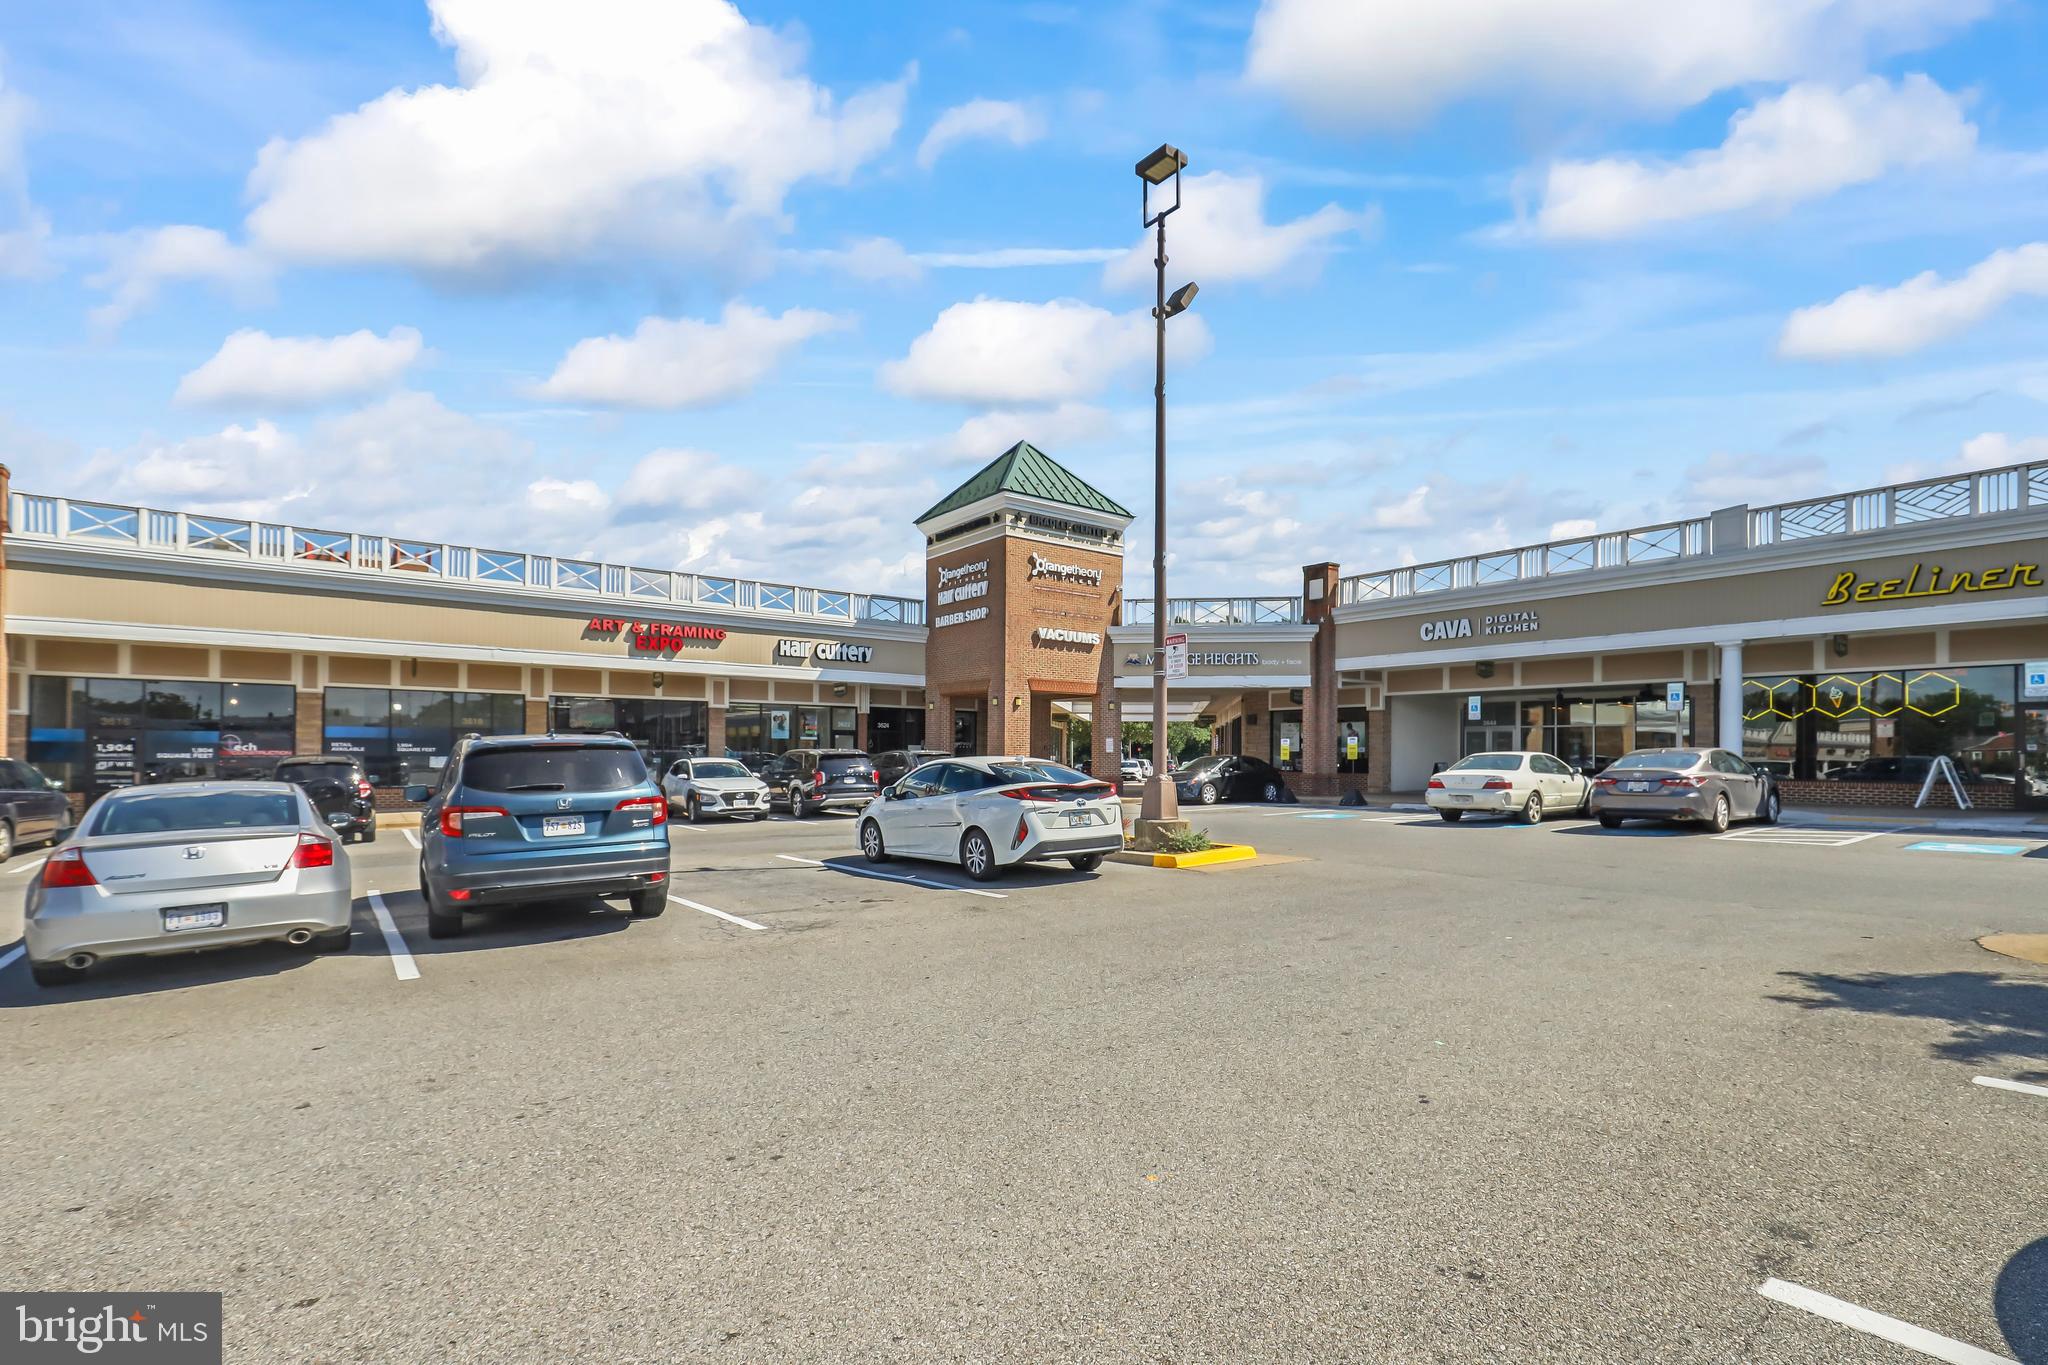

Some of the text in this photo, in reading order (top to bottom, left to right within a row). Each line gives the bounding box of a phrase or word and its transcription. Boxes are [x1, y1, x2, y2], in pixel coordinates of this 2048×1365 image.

[935, 607, 988, 628] BARBER SHOP
[1486, 611, 1538, 624] DIGITAL
[589, 618, 727, 640] ART & FRAMING
[1038, 627, 1101, 645] VACUUMS
[1420, 618, 1472, 641] CAVA
[1485, 622, 1538, 635] KITCHEN
[635, 635, 683, 651] EXPO
[779, 639, 811, 657] Hair
[1204, 652, 1259, 665] HEIGHTS
